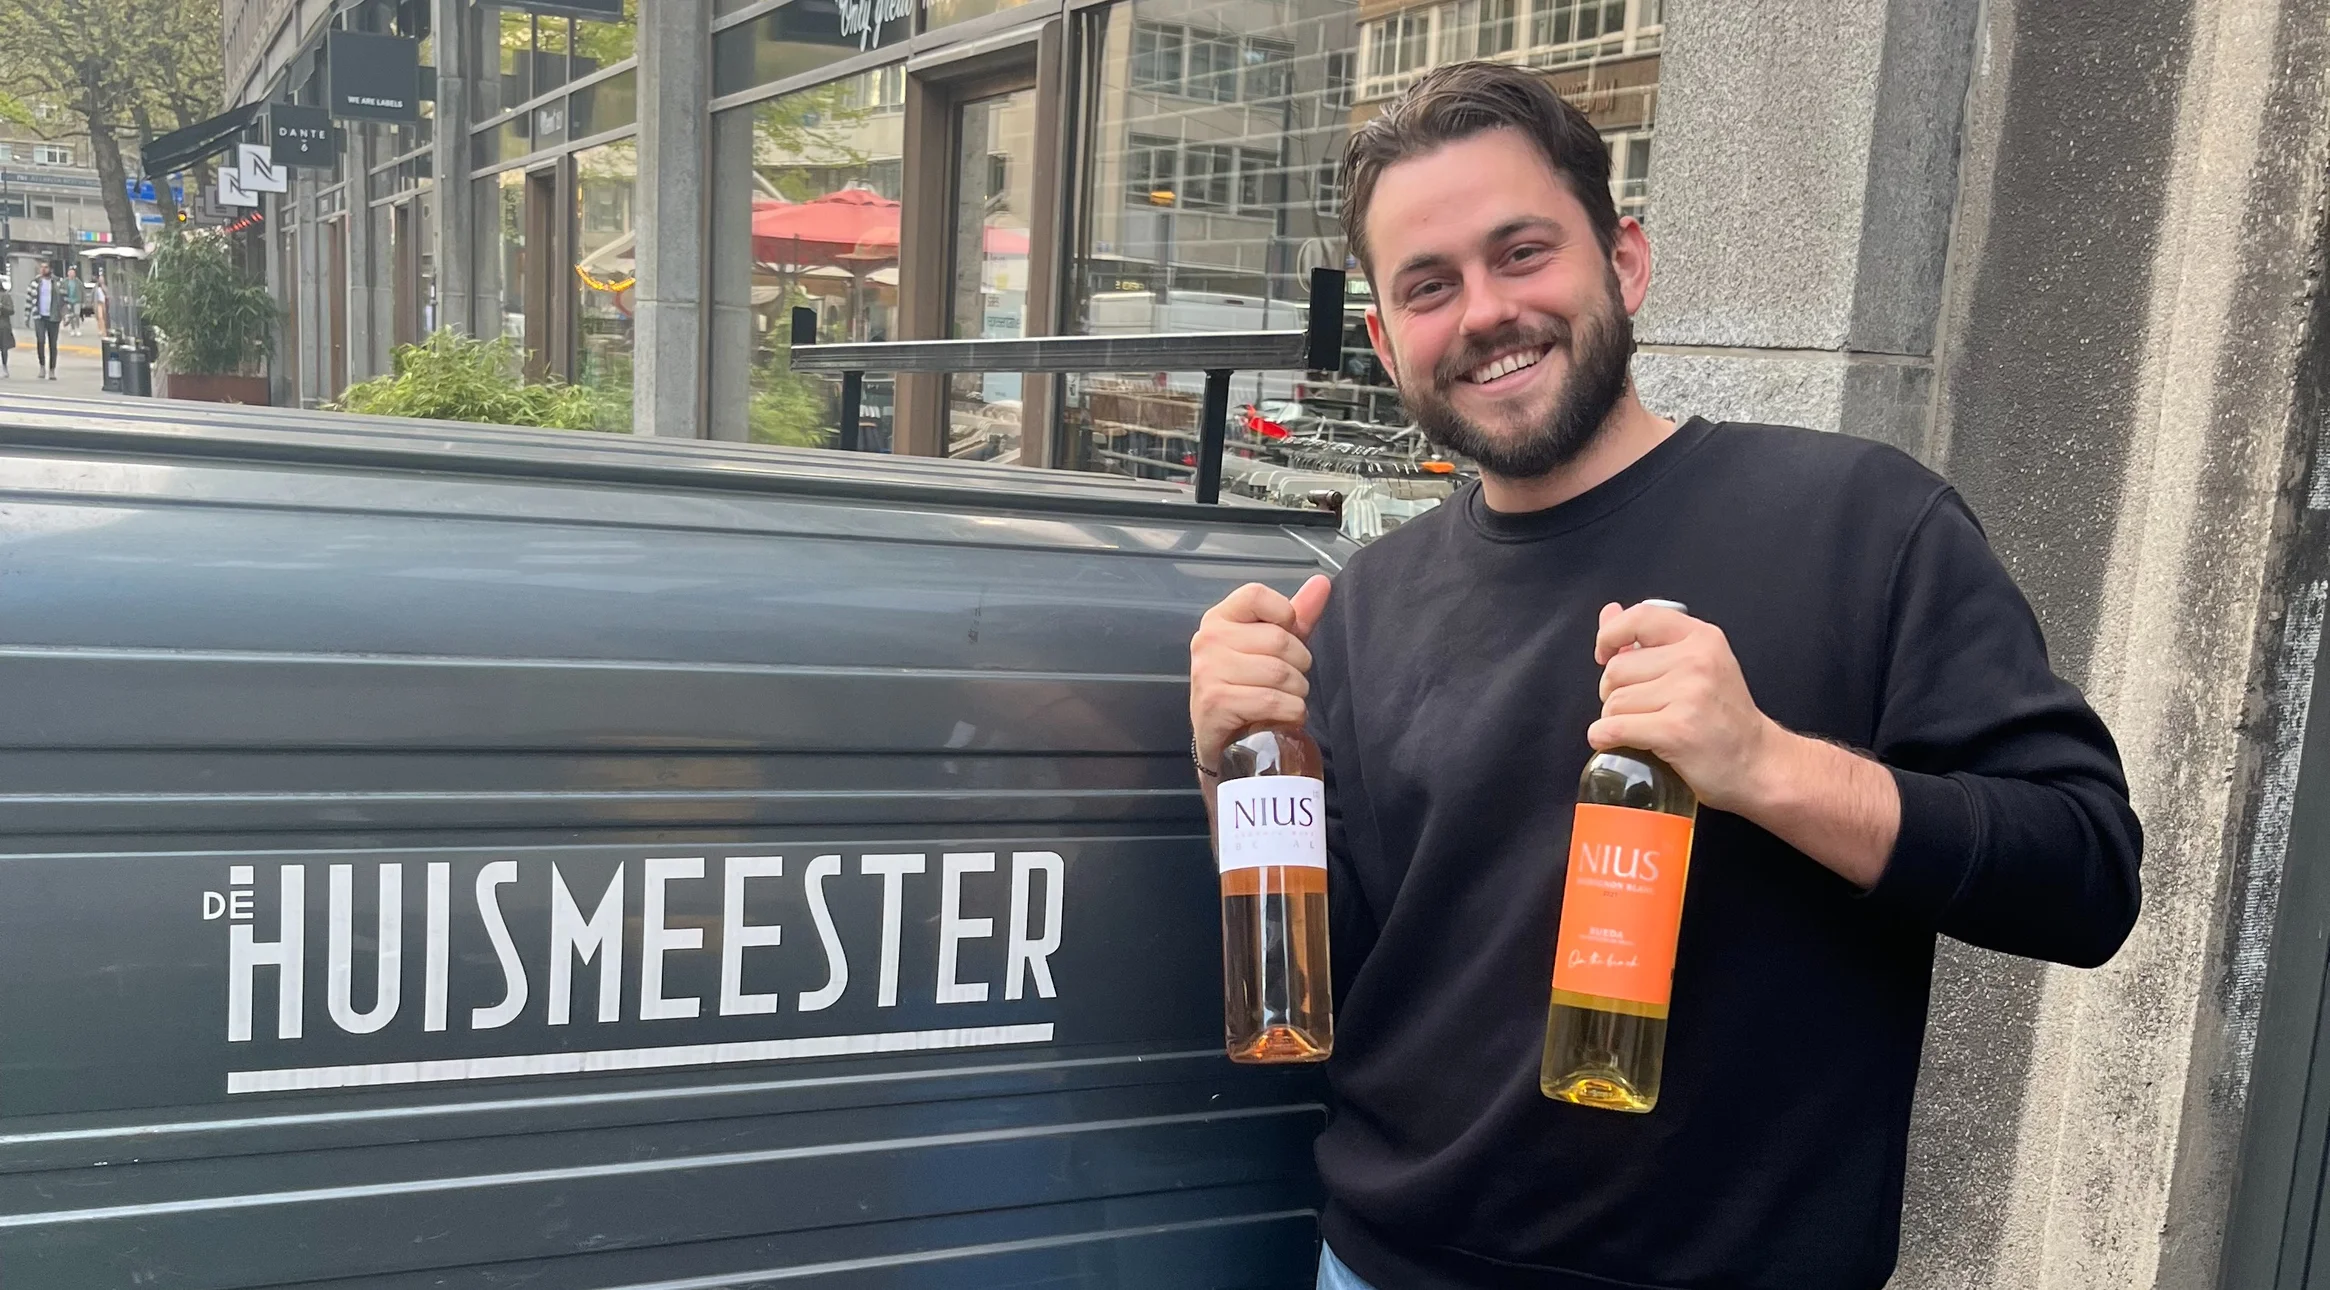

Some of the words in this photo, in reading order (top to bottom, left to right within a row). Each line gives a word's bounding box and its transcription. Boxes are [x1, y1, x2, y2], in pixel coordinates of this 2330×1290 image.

[348, 96, 360, 105] WE
[361, 97, 376, 106] ARE
[377, 99, 403, 108] LABELS
[279, 127, 326, 140] DANTE
[1235, 797, 1313, 830] NIUS
[1579, 842, 1660, 882] NIUS
[203, 890, 254, 920] DE
[228, 851, 1065, 1041] HUISMEESTER
